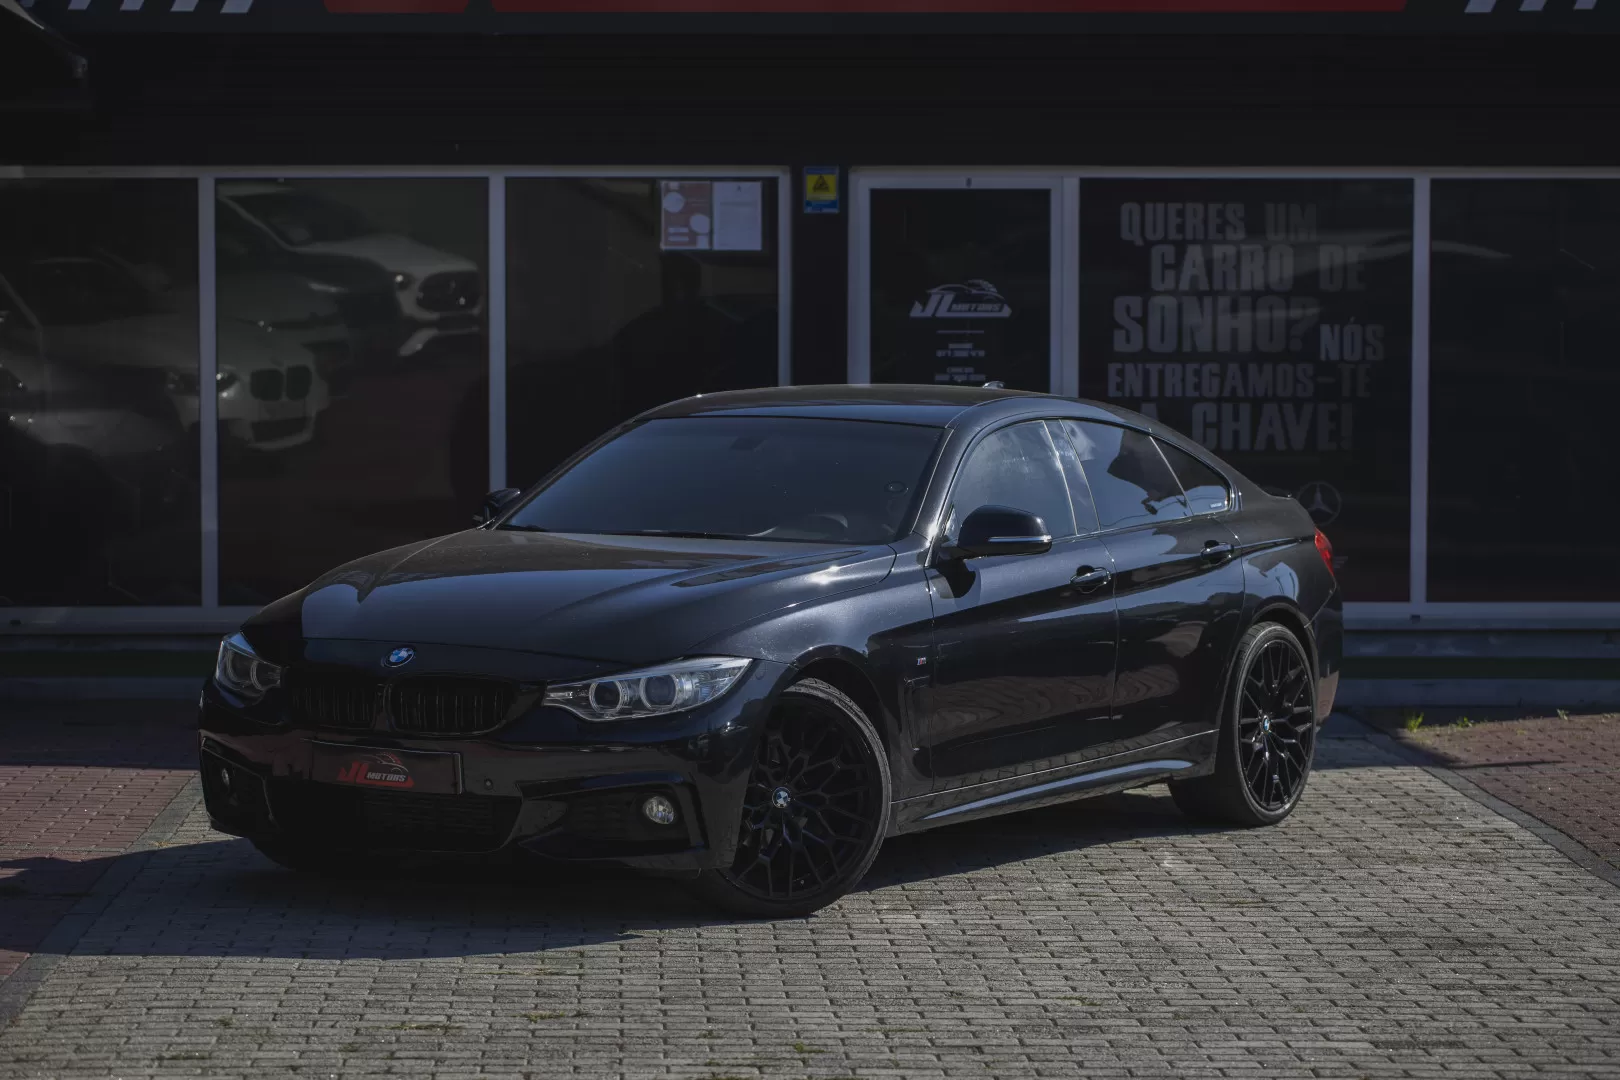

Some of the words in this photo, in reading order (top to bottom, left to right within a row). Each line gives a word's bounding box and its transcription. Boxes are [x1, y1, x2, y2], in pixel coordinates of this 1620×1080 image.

[1120, 202, 1246, 246] QUERES
[1264, 203, 1317, 241] UM
[1151, 243, 1294, 292] CARRO
[1319, 243, 1368, 292] DE
[1113, 295, 1320, 353] SONHO?
[1319, 316, 1385, 362] NÓS
[1107, 362, 1372, 398] ENTREGAMOS-TE
[1191, 403, 1355, 451] CHAVE!
[366, 771, 406, 782] MOTORS
